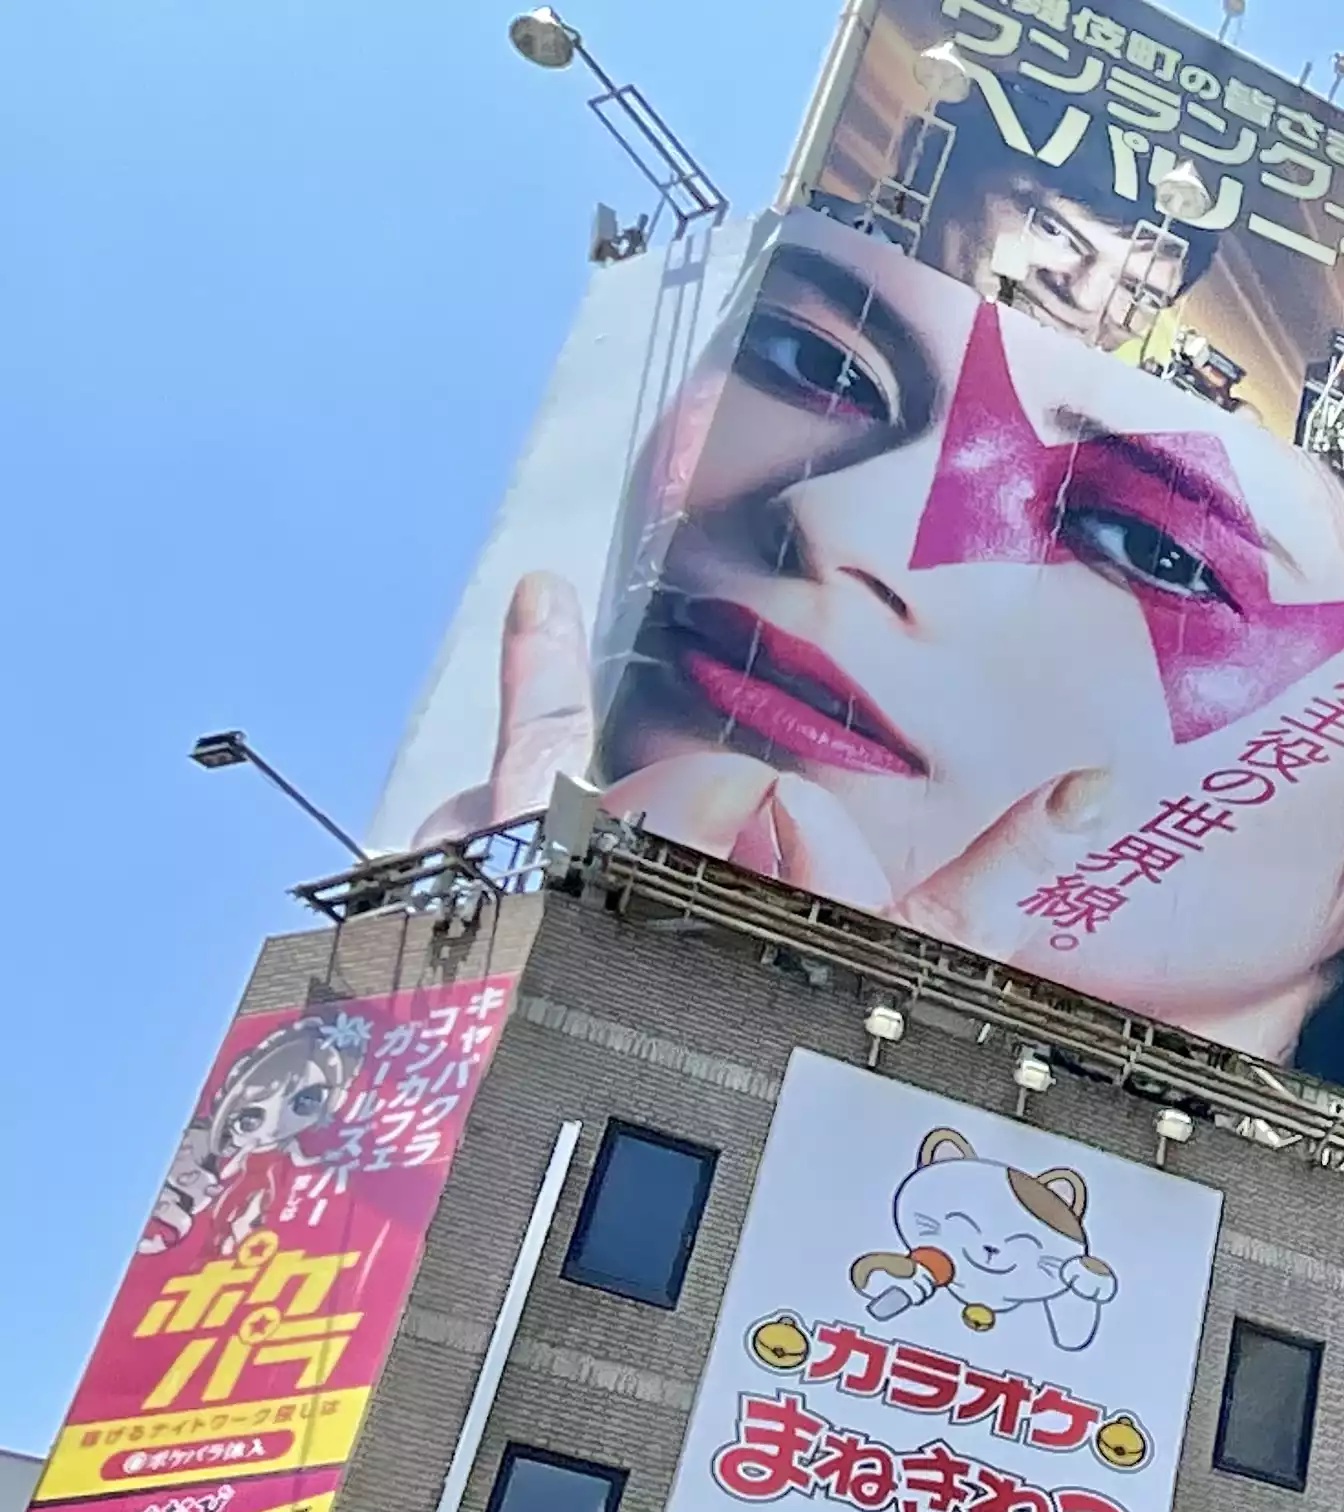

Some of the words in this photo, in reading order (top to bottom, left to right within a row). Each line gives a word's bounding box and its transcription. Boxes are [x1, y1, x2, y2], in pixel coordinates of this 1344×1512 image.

[364, 1006, 458, 1173] コンカフェ
[404, 986, 506, 1168] キャバクラ
[808, 1321, 1104, 1450] カラオケ
